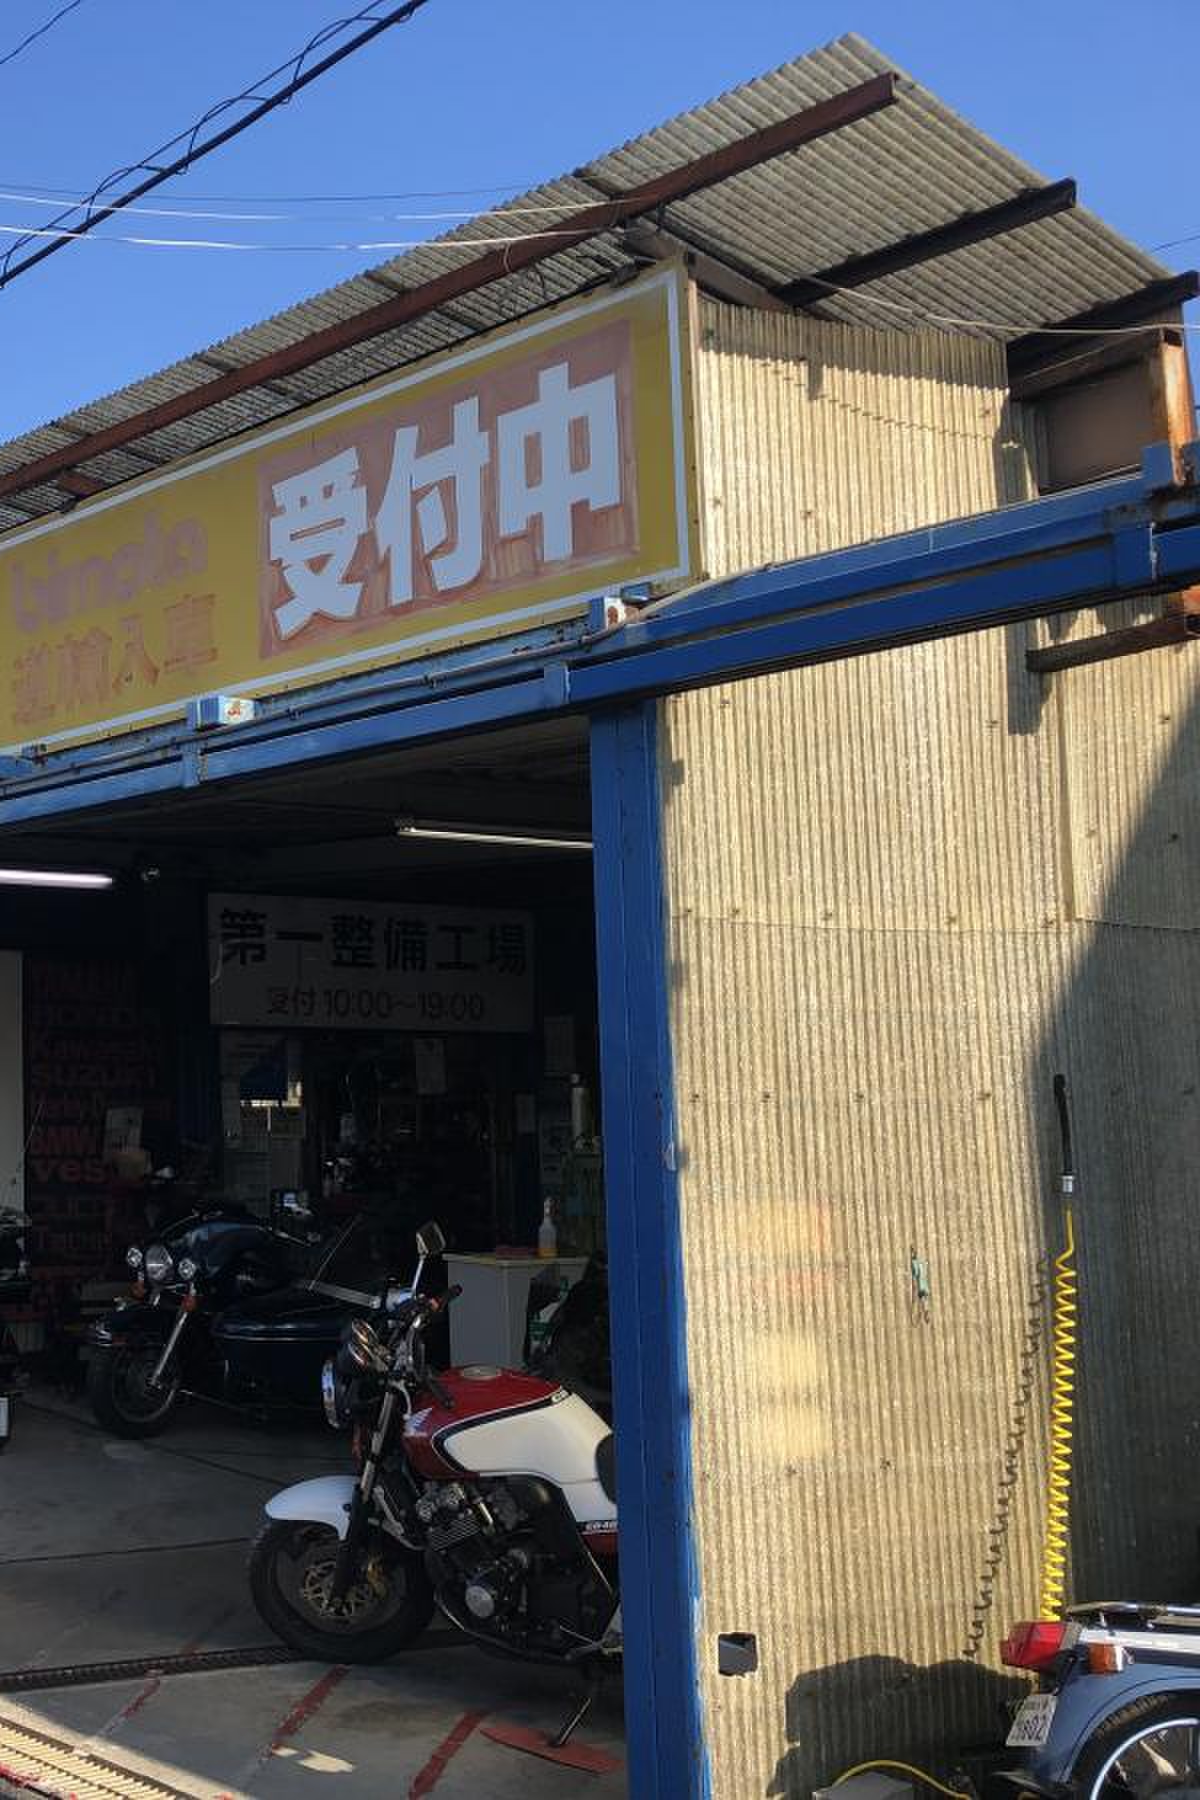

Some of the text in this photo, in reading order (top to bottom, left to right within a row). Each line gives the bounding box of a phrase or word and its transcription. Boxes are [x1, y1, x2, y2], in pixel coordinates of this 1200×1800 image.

[268, 361, 622, 642] 受付中
[220, 906, 527, 977] 第一整備工場
